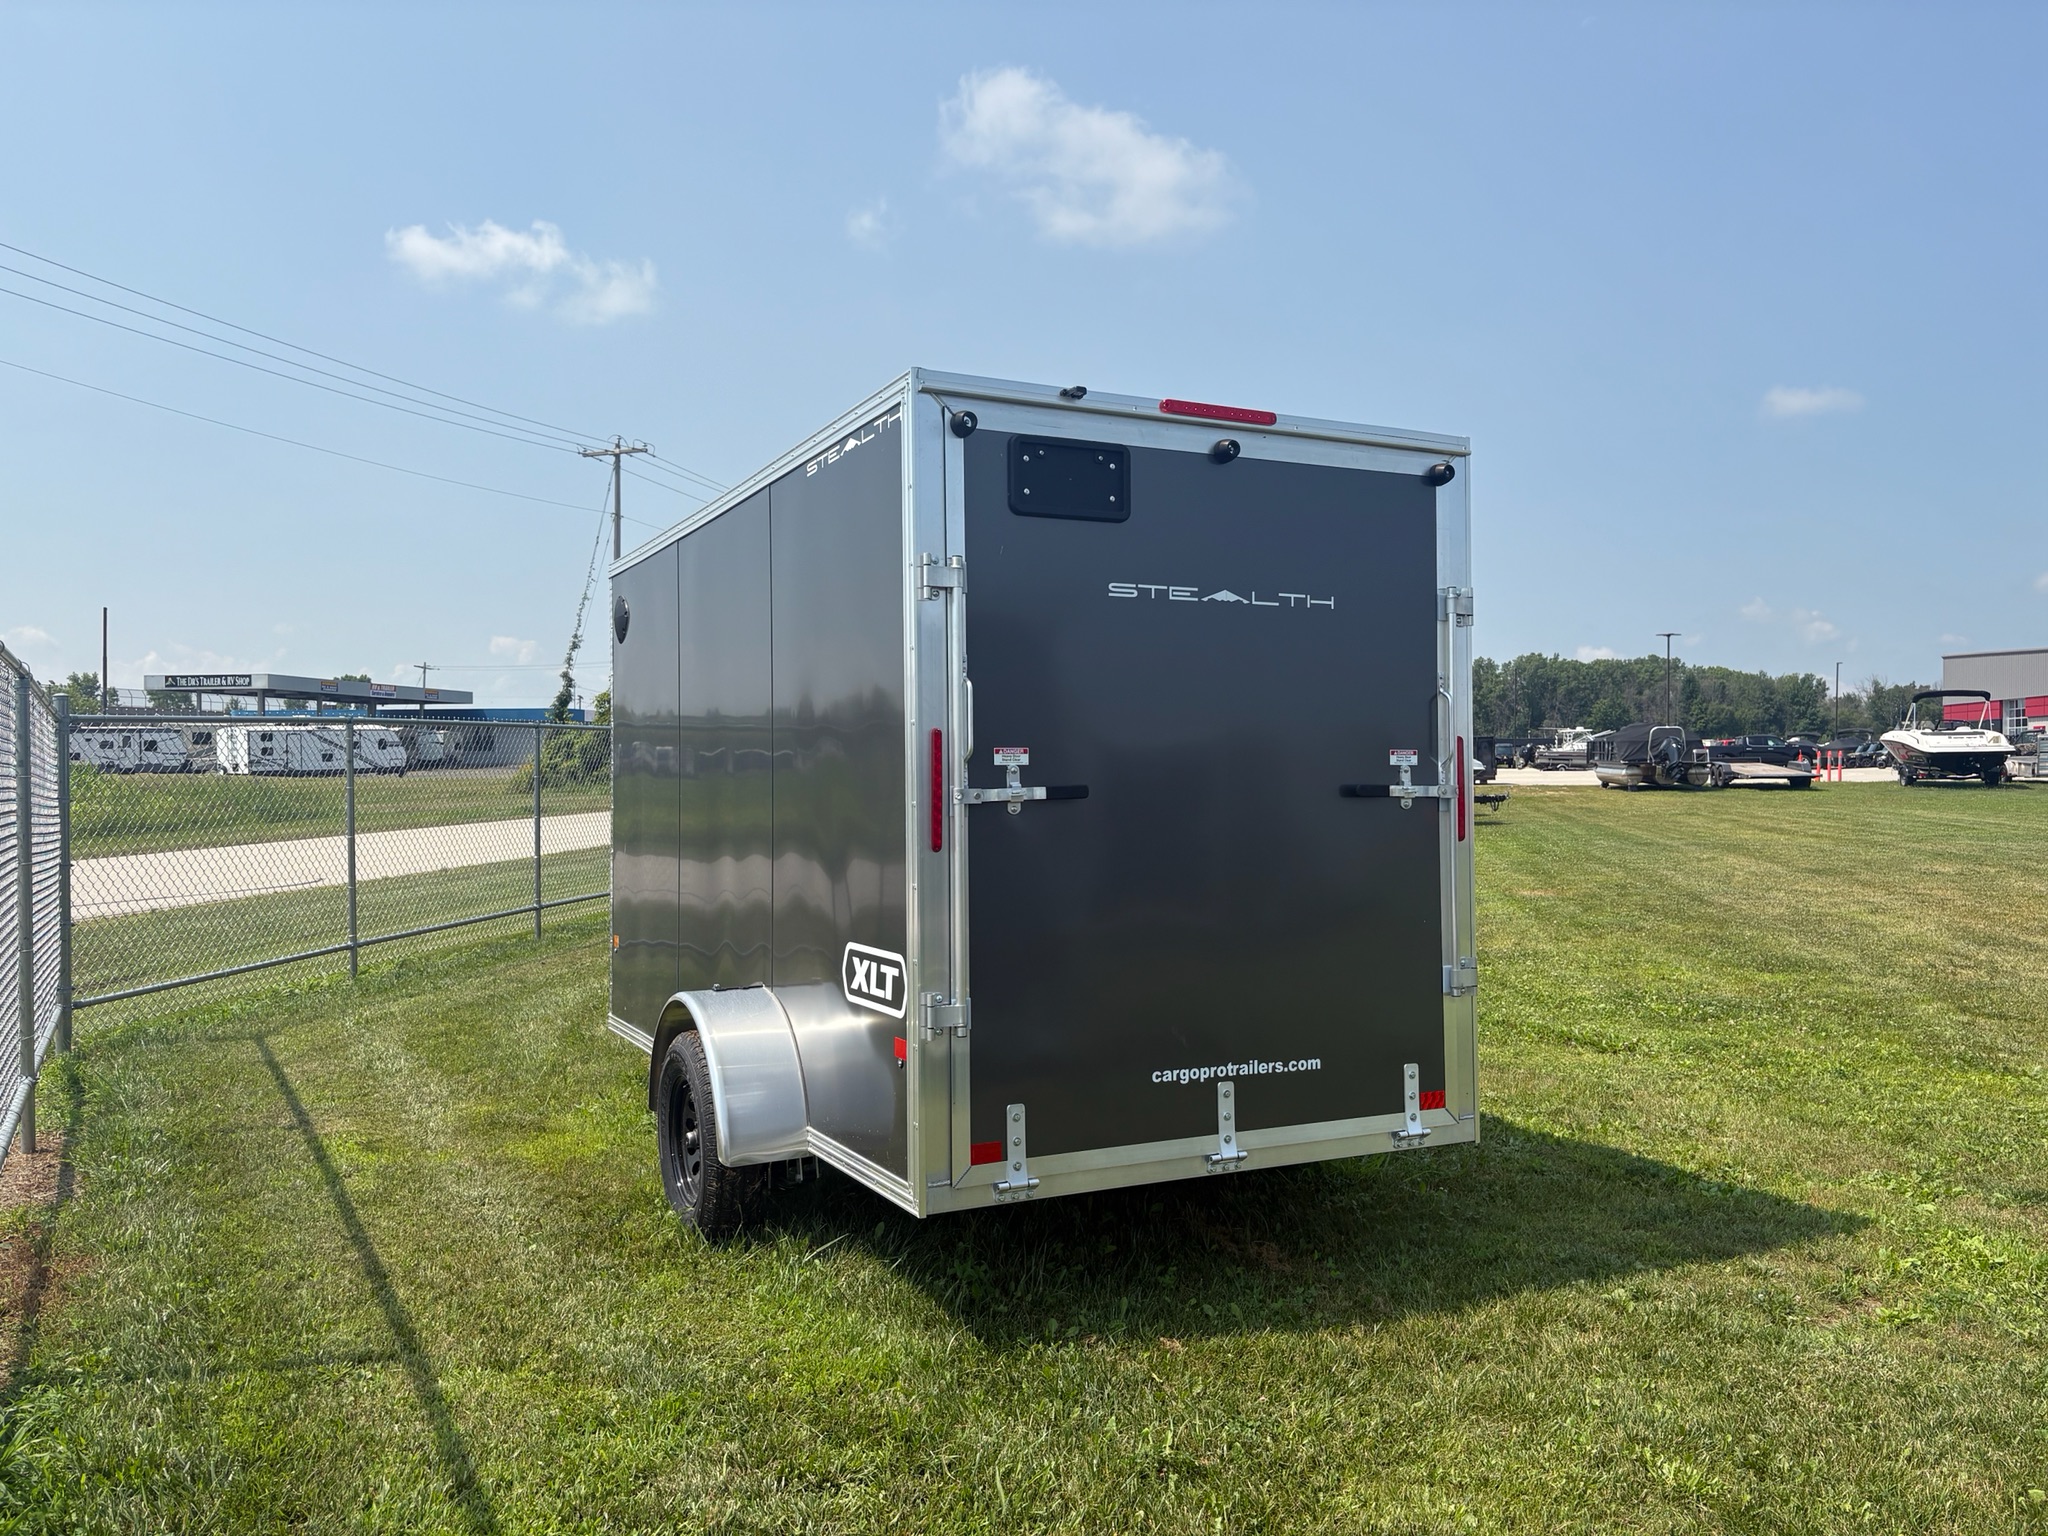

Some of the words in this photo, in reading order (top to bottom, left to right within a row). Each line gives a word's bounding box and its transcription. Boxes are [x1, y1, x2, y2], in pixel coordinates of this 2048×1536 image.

[1107, 582, 1335, 610] STEALTH
[200, 676, 221, 686] TRAILER
[221, 676, 227, 686] &
[227, 676, 235, 686] RV
[235, 676, 250, 686] SHOP
[850, 956, 899, 1001] XLT
[1152, 1058, 1322, 1084] cargoprotrailers.com
